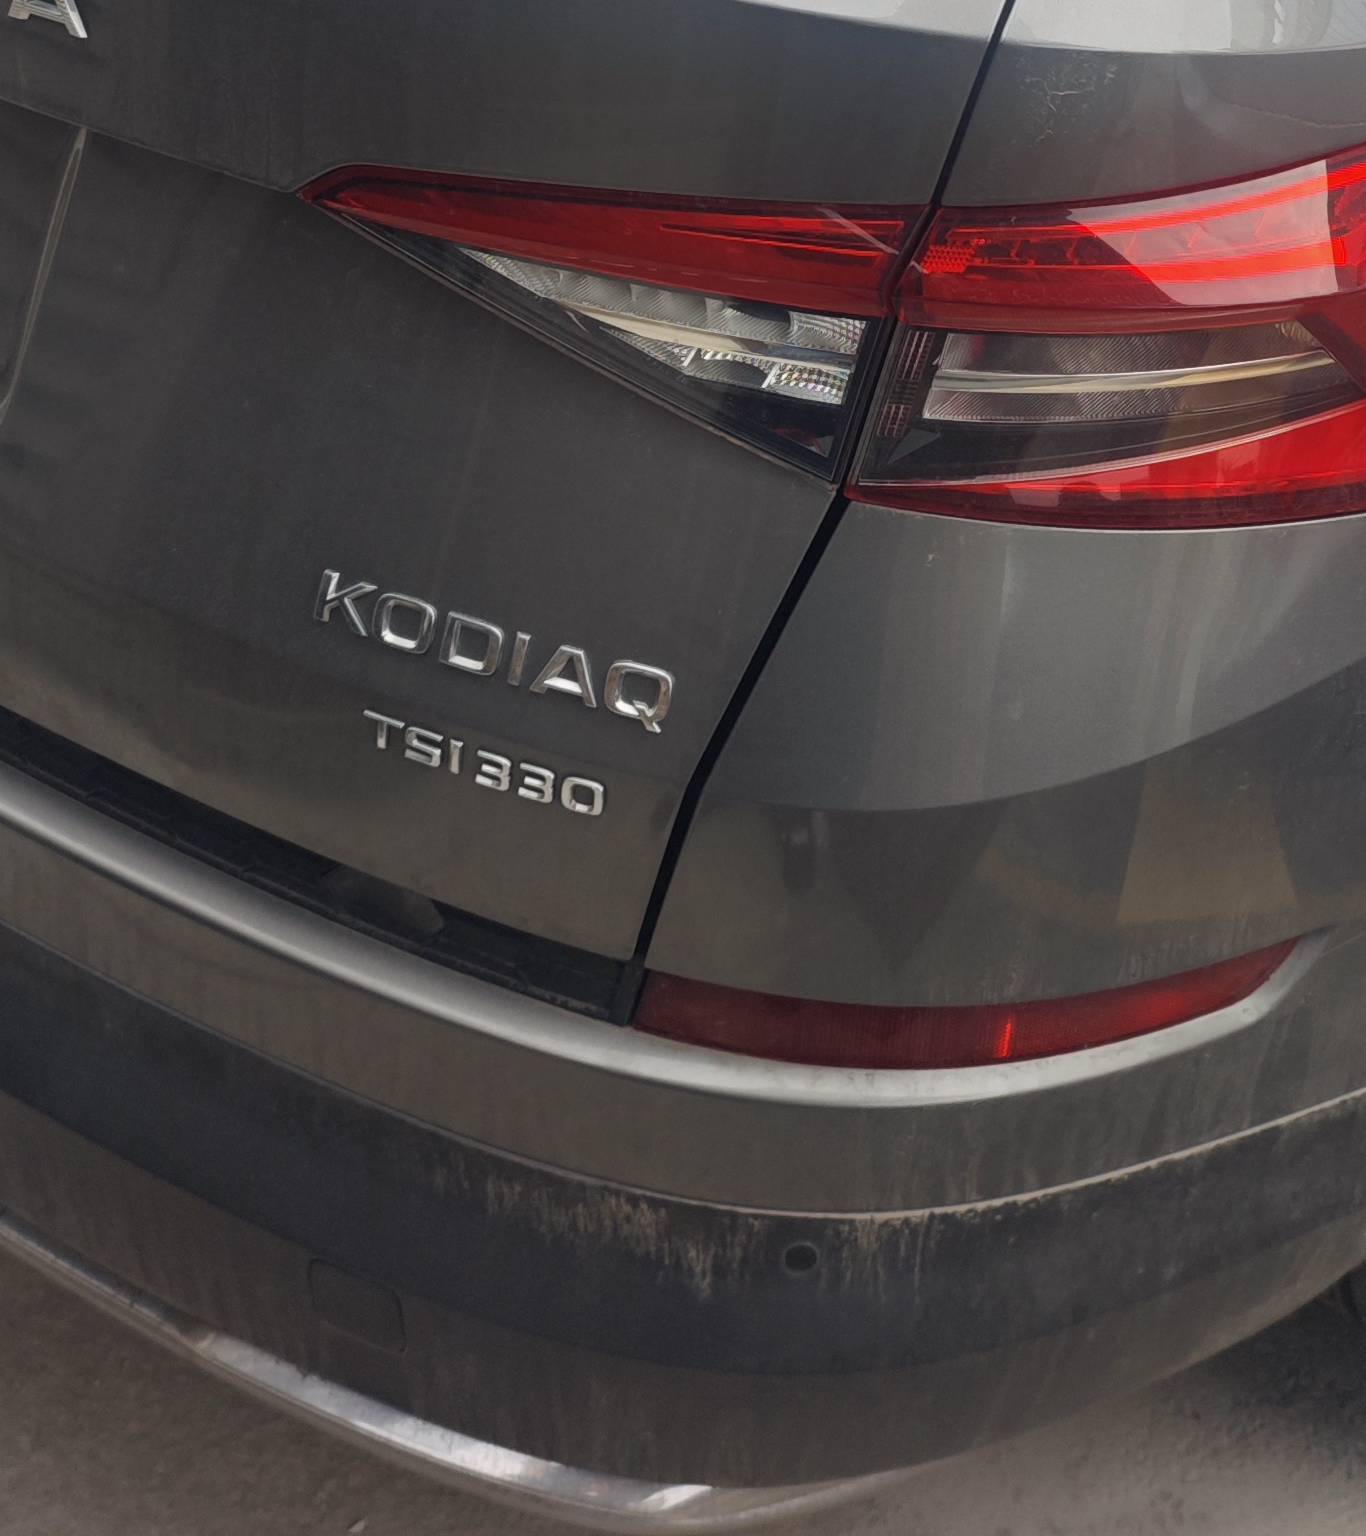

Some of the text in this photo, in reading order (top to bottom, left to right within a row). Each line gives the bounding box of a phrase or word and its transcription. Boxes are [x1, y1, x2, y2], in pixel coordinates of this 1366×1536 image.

[313, 568, 675, 734] KODIAQ
[363, 709, 605, 816] TSI 330
